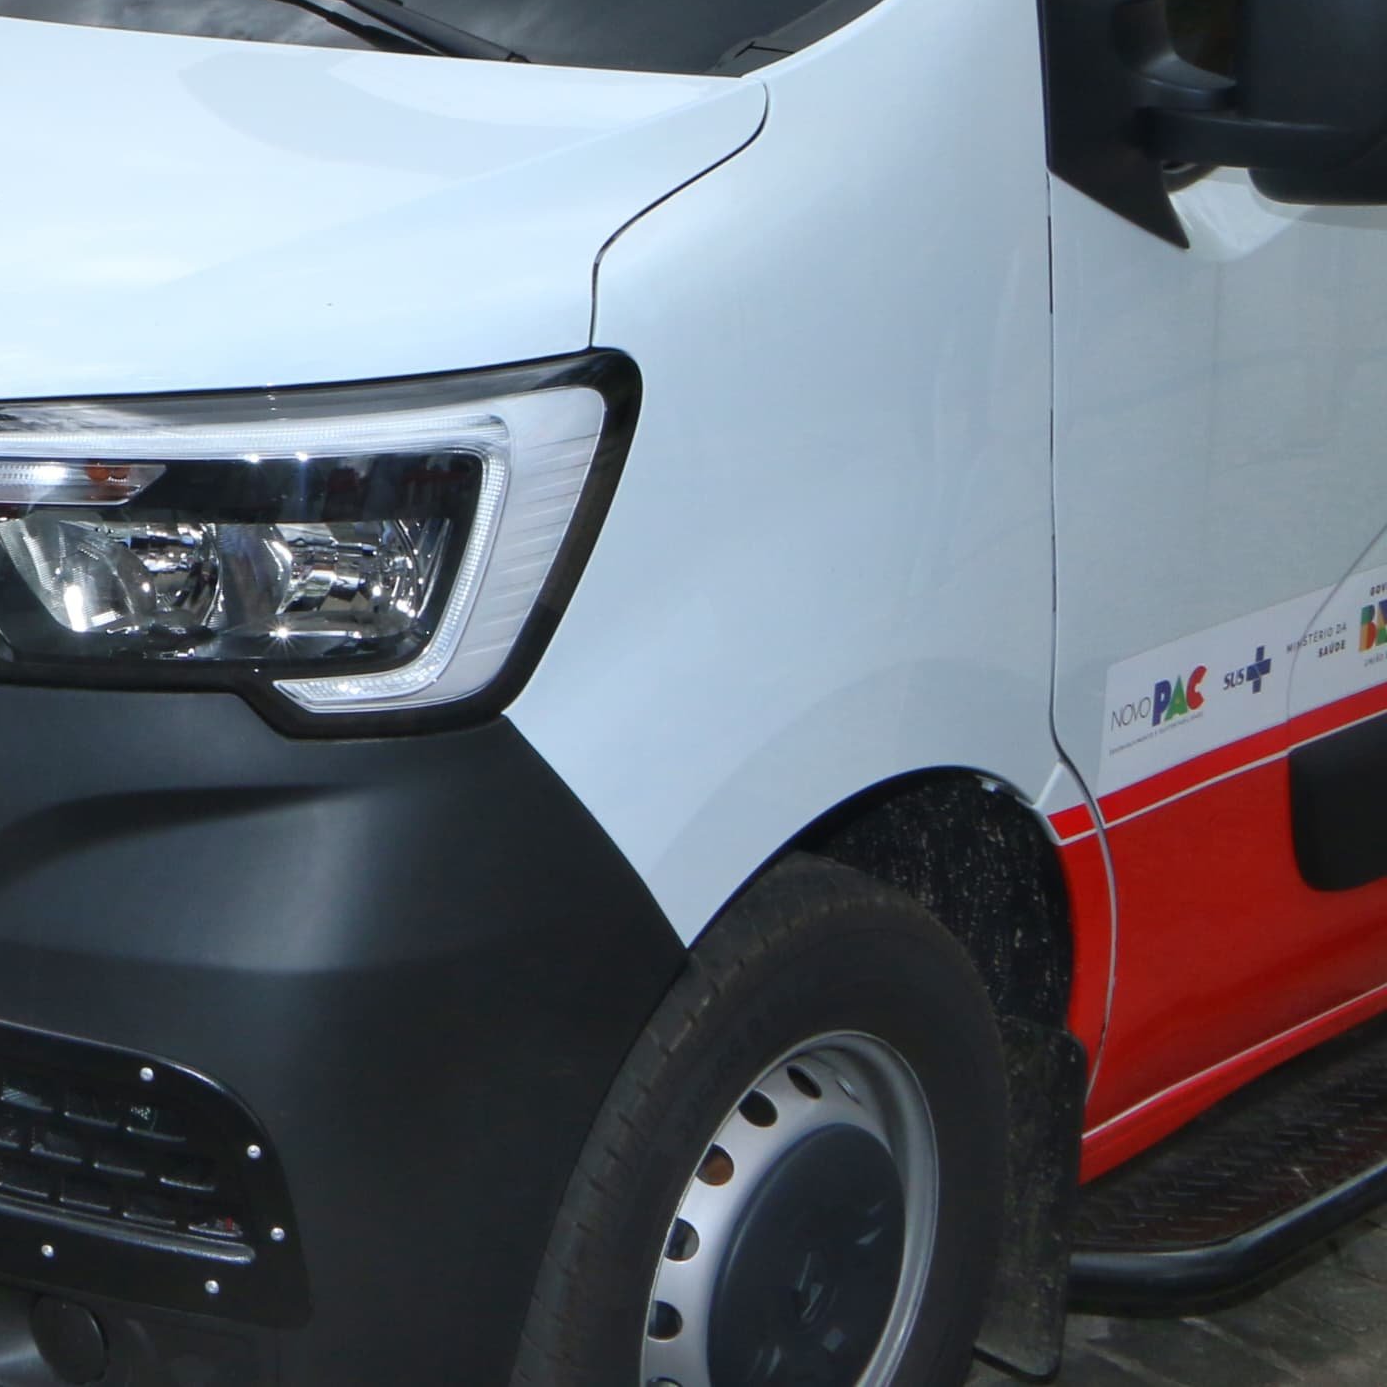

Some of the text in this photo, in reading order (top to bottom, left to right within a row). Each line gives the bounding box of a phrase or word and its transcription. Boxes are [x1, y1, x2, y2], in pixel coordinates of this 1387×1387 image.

[1110, 665, 1207, 732] NOVO PAC
[1223, 667, 1245, 691] SUS
